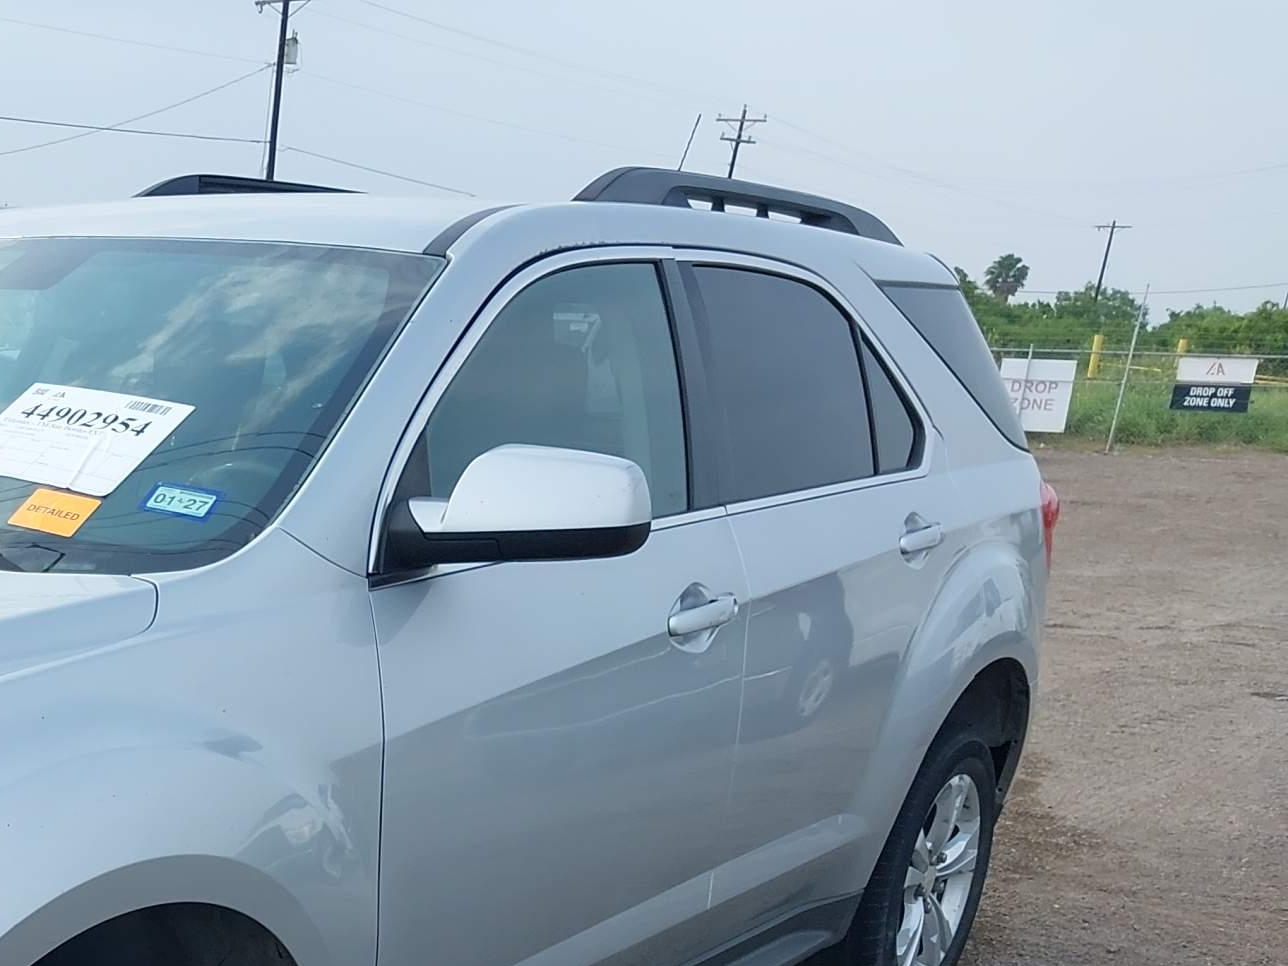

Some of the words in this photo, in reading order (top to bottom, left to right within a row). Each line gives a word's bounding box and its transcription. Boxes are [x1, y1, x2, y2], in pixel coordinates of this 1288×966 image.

[1010, 379, 1059, 394] DROP
[1189, 387, 1216, 397] DROP
[1216, 387, 1235, 398] OFF
[1183, 397, 1210, 407] ZONE
[1210, 398, 1237, 408] ONLY
[21, 403, 153, 437] 44902954
[26, 503, 80, 522] DETAILED
